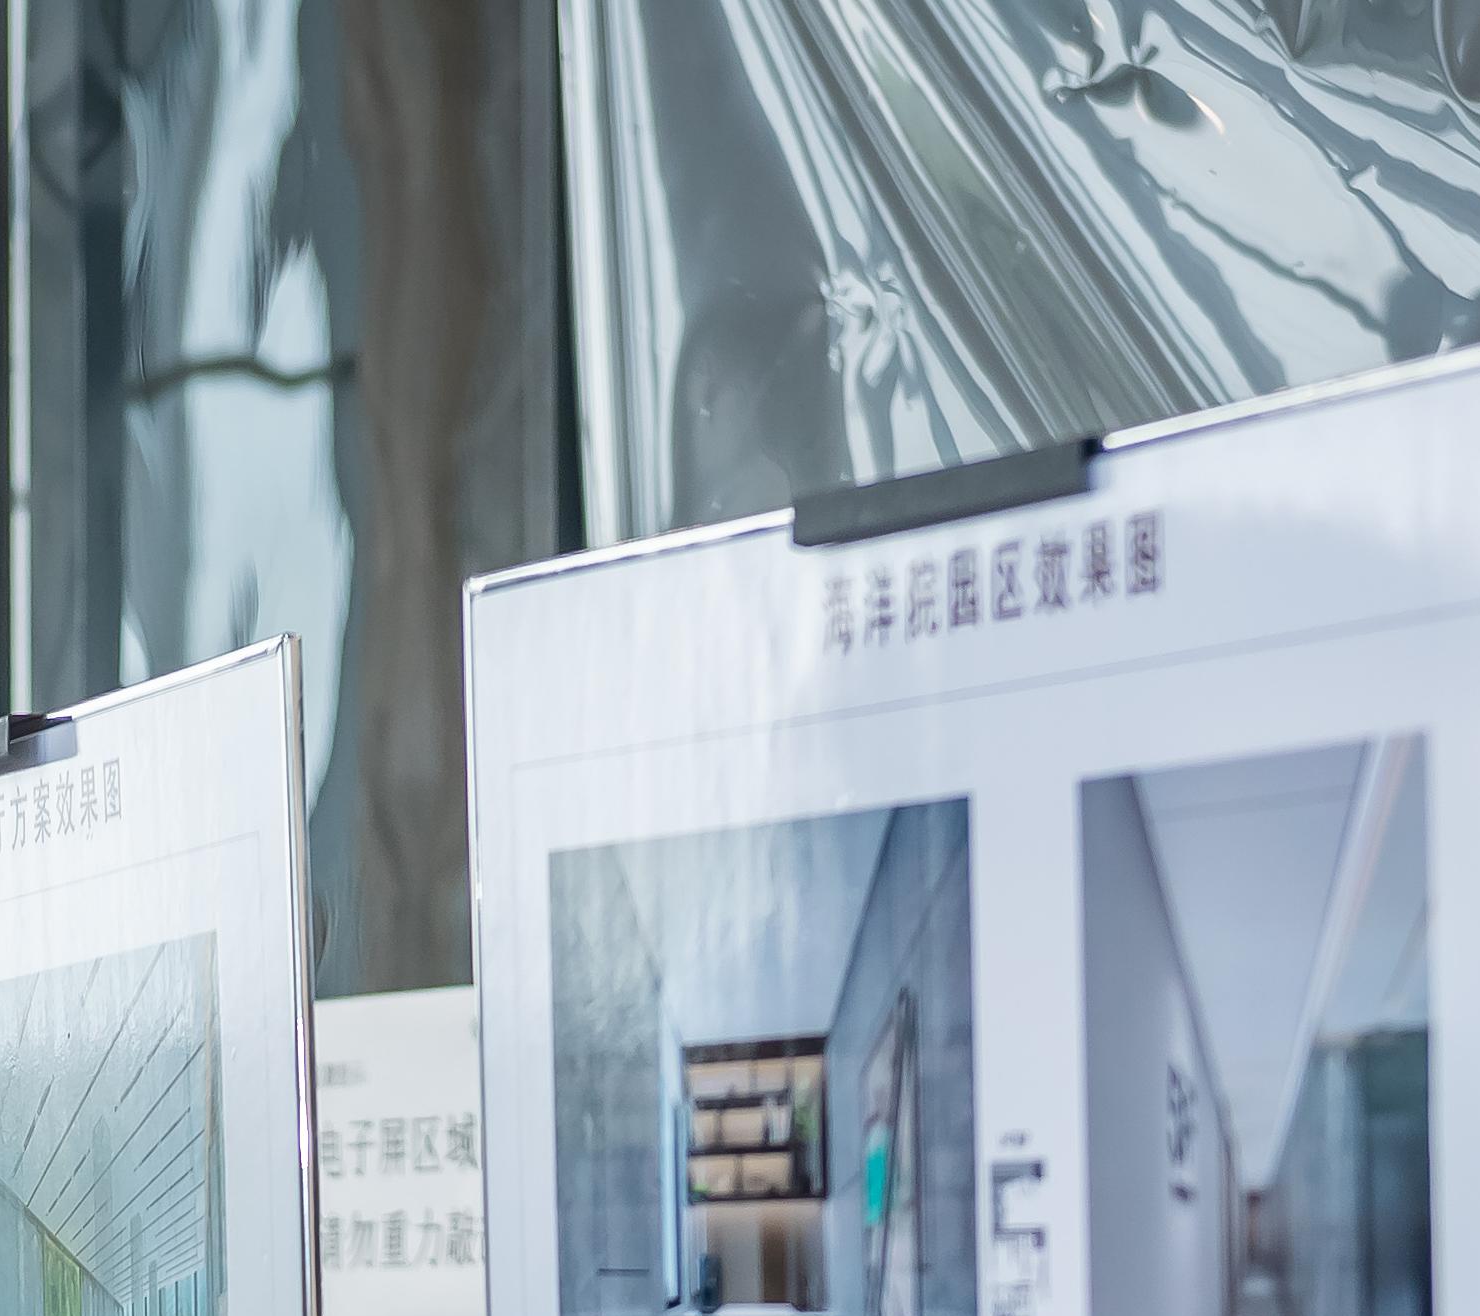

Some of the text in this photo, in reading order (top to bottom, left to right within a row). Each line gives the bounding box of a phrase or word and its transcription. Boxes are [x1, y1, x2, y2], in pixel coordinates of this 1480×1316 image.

[823, 510, 1165, 657] 海洋院园区效果图
